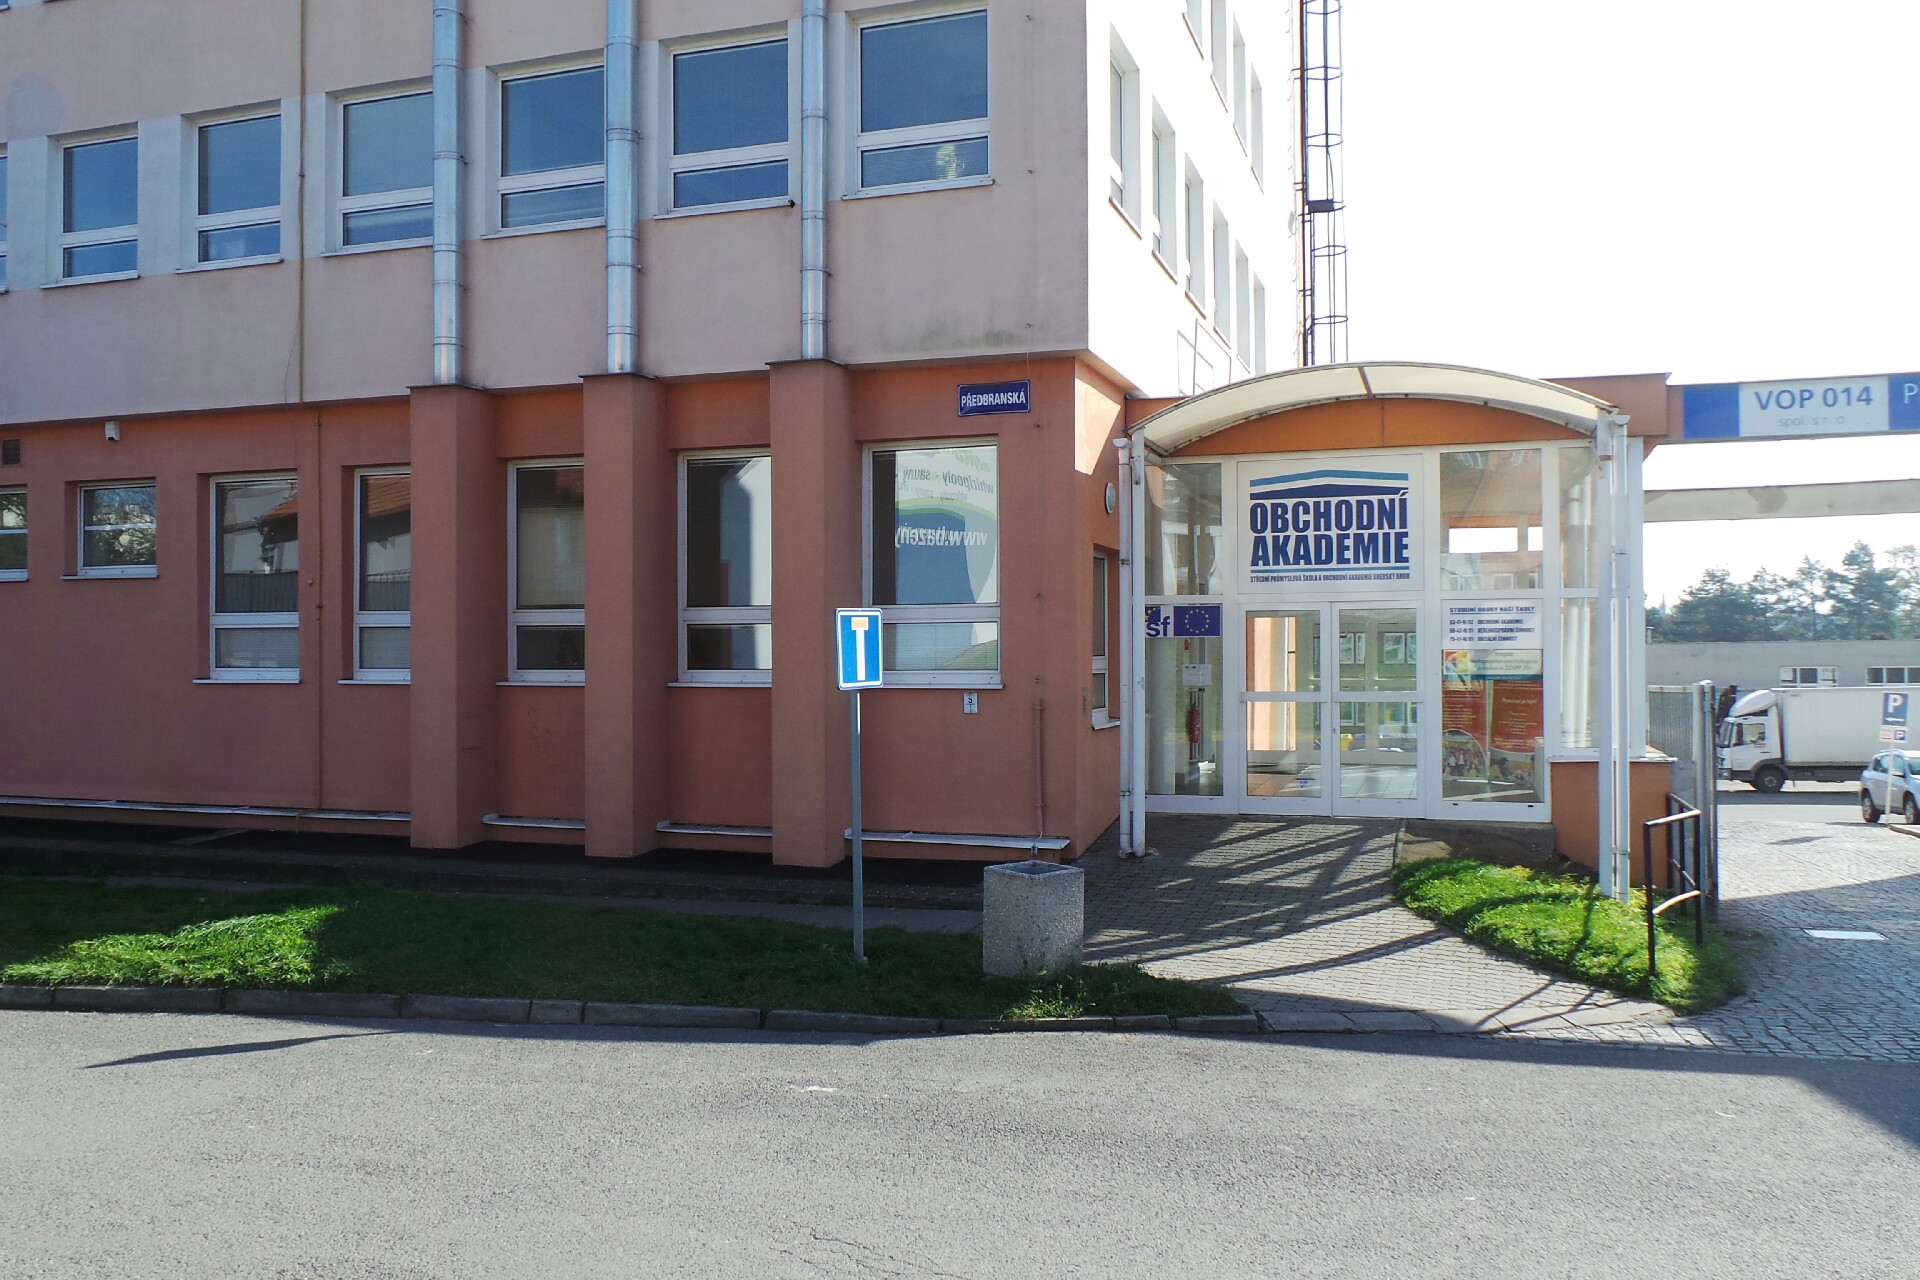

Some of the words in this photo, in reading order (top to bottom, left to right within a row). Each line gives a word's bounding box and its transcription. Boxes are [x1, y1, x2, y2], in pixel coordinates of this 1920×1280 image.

[961, 387, 1026, 408] PŘEDBRANSKÁ
[1754, 388, 1813, 411] VOP
[1822, 385, 1874, 408] 014
[1903, 382, 1920, 404] P
[1250, 490, 1408, 534] OBCHODNÍ
[1250, 531, 1409, 566] AKADEMIE
[1250, 574, 1270, 583] STŘEDNÍ
[1270, 573, 1302, 583] PRŮMYSLOVÁ
[1302, 573, 1318, 582] ŠKOLA
[1323, 572, 1348, 581] OBCHODNÍ
[1349, 573, 1373, 581] AKADEMIE
[1373, 572, 1396, 580] UHERSKÝ
[1888, 694, 1903, 713] P
